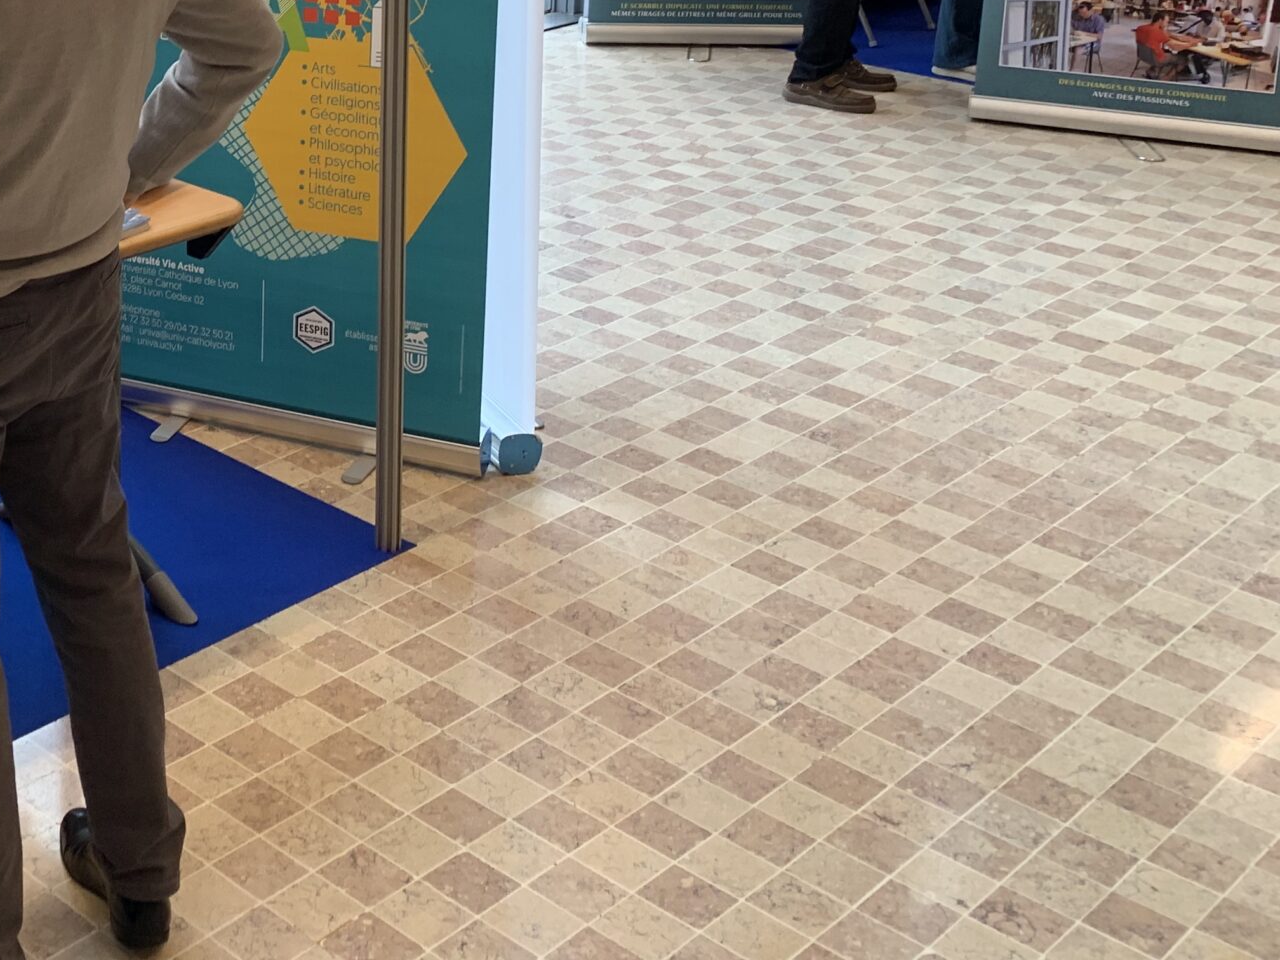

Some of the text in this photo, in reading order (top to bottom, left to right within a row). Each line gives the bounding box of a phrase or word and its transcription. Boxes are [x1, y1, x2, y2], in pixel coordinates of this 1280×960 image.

[762, 11, 784, 19] POUR
[783, 11, 803, 19] TOUS
[311, 61, 336, 76] Arts
[1058, 78, 1075, 87] DES
[1076, 79, 1123, 91] ÉCHANGES
[1123, 84, 1136, 93] EN
[1137, 85, 1166, 95] TOUTE
[310, 93, 381, 111] et religions
[1093, 91, 1115, 100] AVEC
[1115, 93, 1134, 102] DES
[310, 106, 380, 129] Géopolitiq
[309, 123, 380, 141] et économ
[309, 136, 381, 157] Philosophie
[308, 153, 381, 173] et psycholo
[308, 167, 357, 185] Histoire
[308, 182, 372, 202] Littérature
[308, 196, 364, 216] Sciences
[161, 258, 177, 270] Vie
[177, 261, 205, 274] Active
[121, 263, 239, 290] niversité Catholique de Lyon
[130, 274, 182, 291] place Carnot
[143, 287, 164, 299] Lyon
[193, 295, 205, 306] 02
[121, 304, 161, 318] éléphone
[189, 324, 199, 335] 72
[200, 326, 211, 338] 32
[212, 328, 224, 339] 50
[299, 322, 329, 337] EESPIG
[344, 328, 379, 342] établisse
